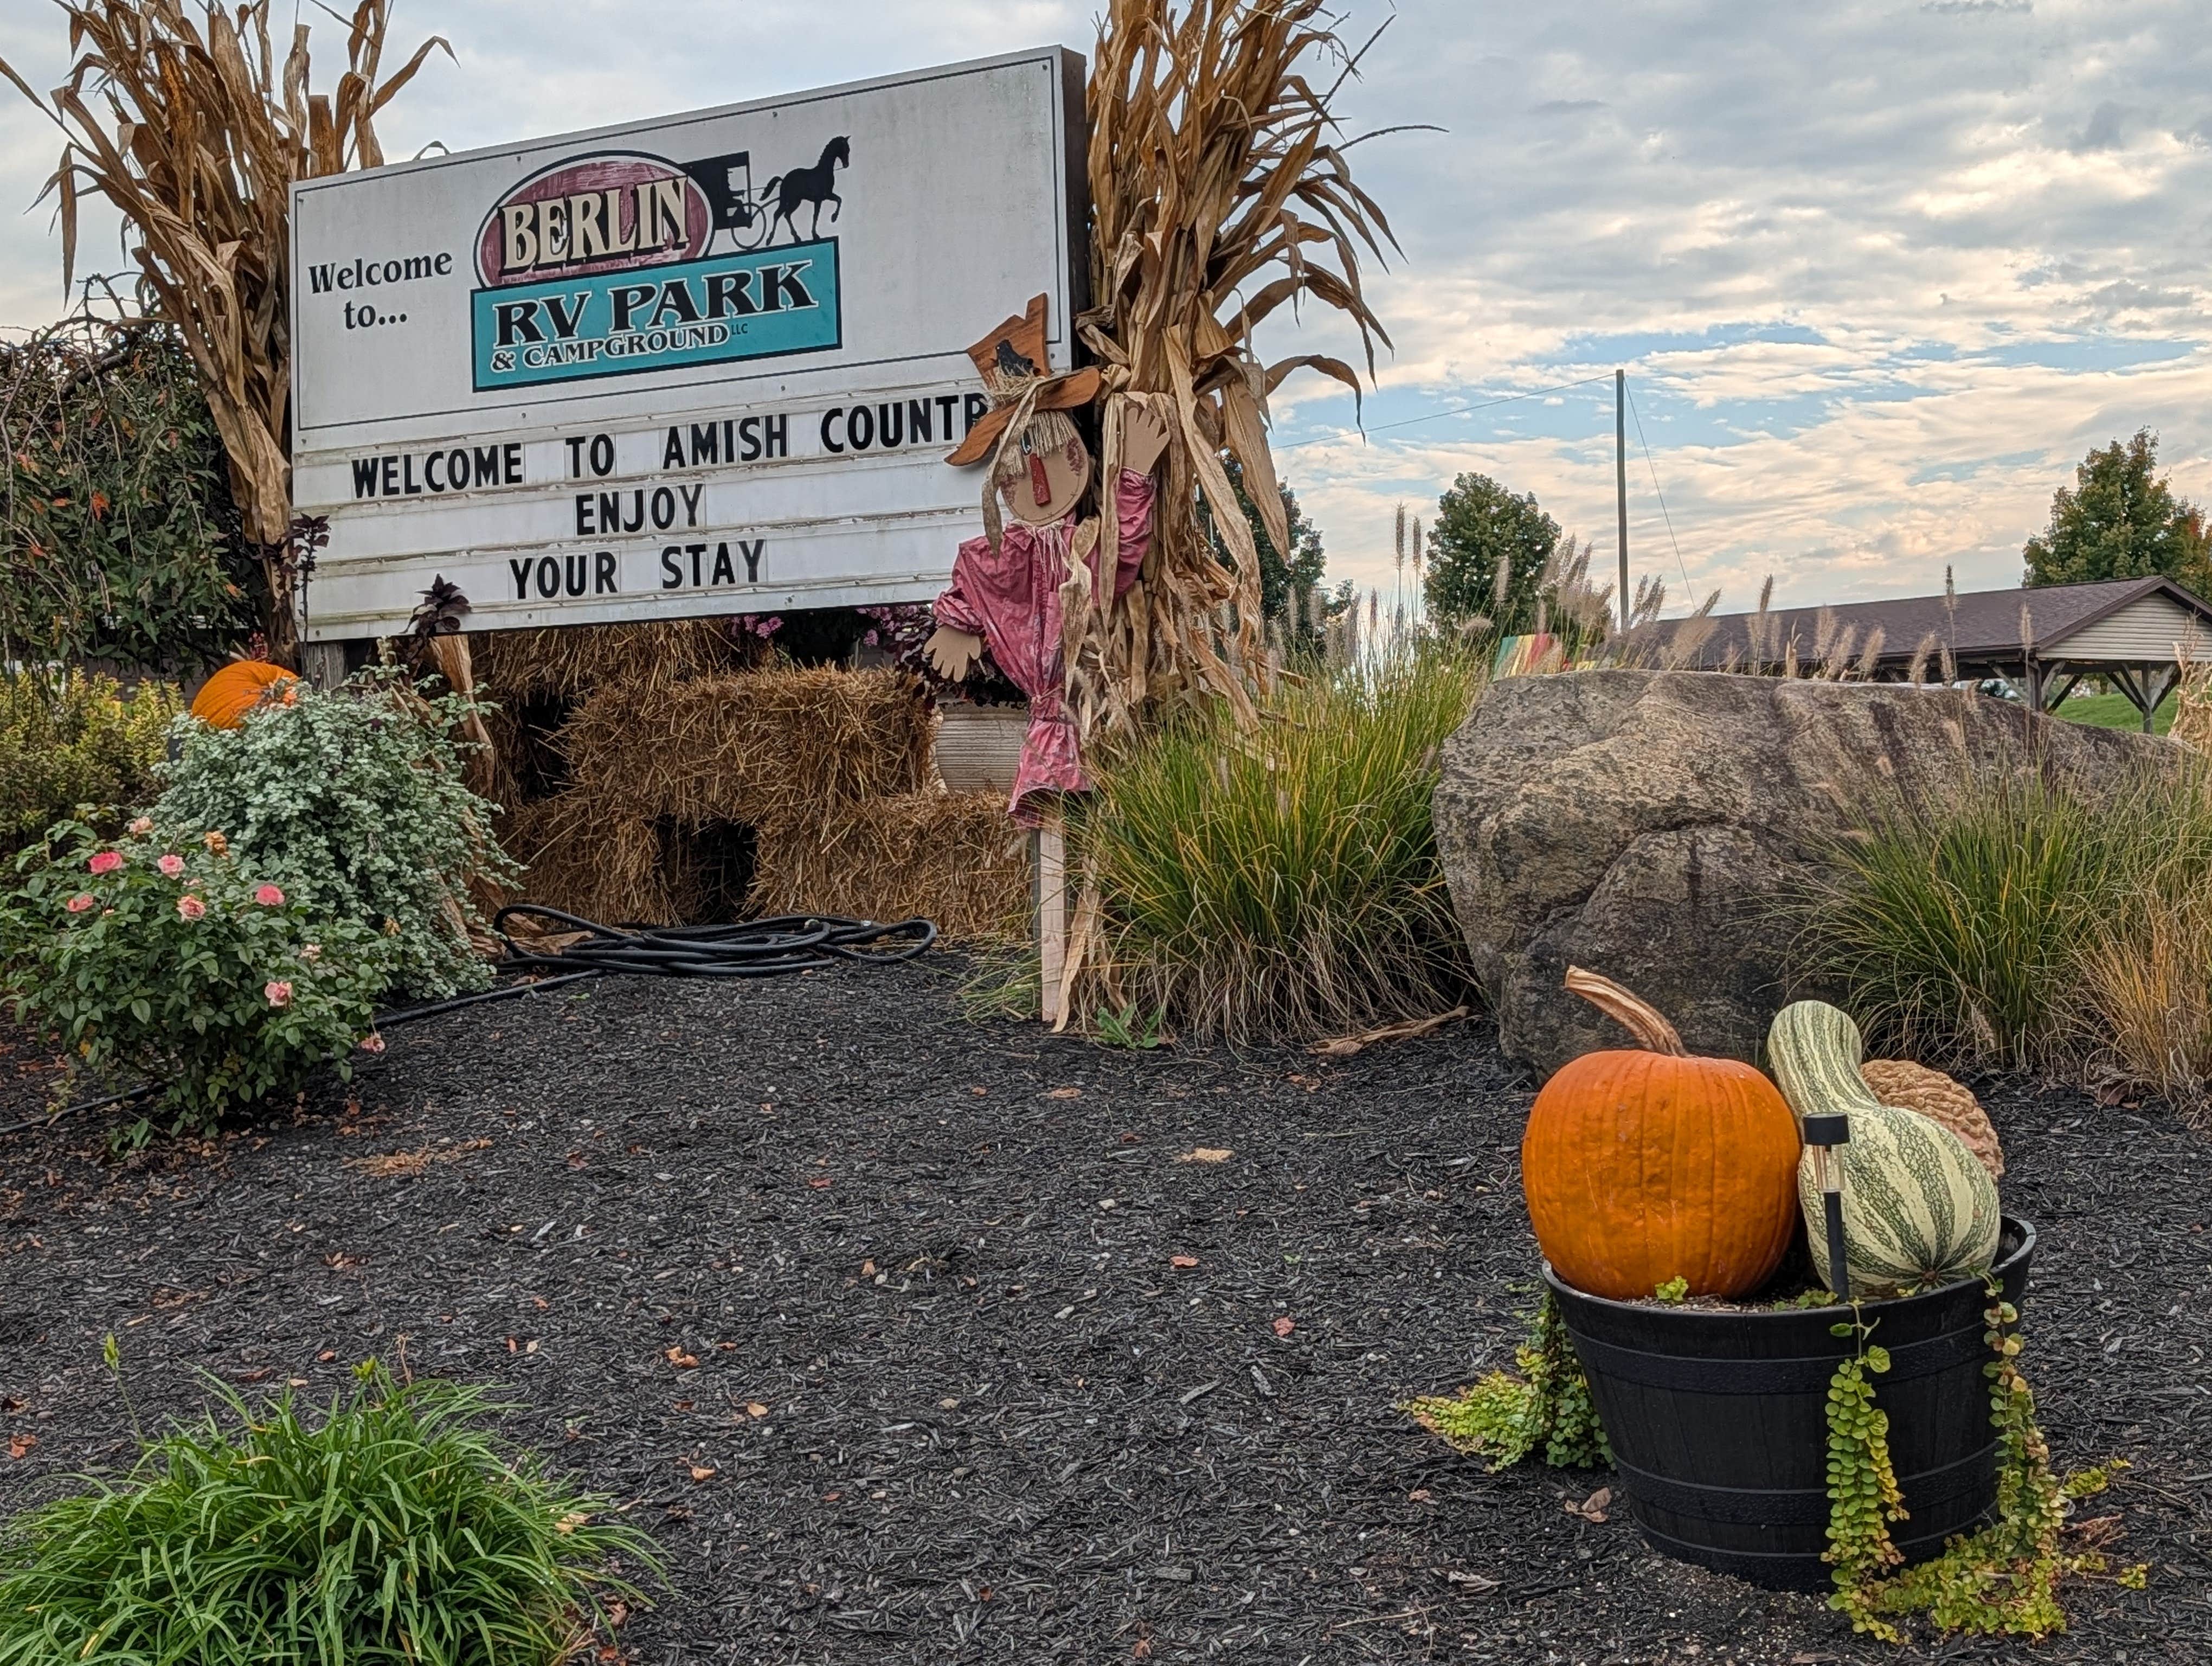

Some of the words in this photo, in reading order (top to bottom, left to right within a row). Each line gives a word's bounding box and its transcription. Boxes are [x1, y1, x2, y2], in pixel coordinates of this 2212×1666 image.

[500, 176, 690, 274] BERLIN
[308, 252, 452, 294] Welcome
[344, 300, 408, 330] to...
[492, 291, 593, 350] RV
[608, 260, 819, 335] PARK
[490, 351, 516, 372] &
[523, 324, 731, 367] CAMPGROUND
[731, 324, 748, 336] LLC
[352, 443, 523, 498] WELCOME
[565, 434, 614, 478] TO
[663, 414, 788, 470] AMISH
[576, 483, 704, 536] ENJOY
[510, 552, 618, 599] YOUR
[661, 539, 764, 589] STAY
